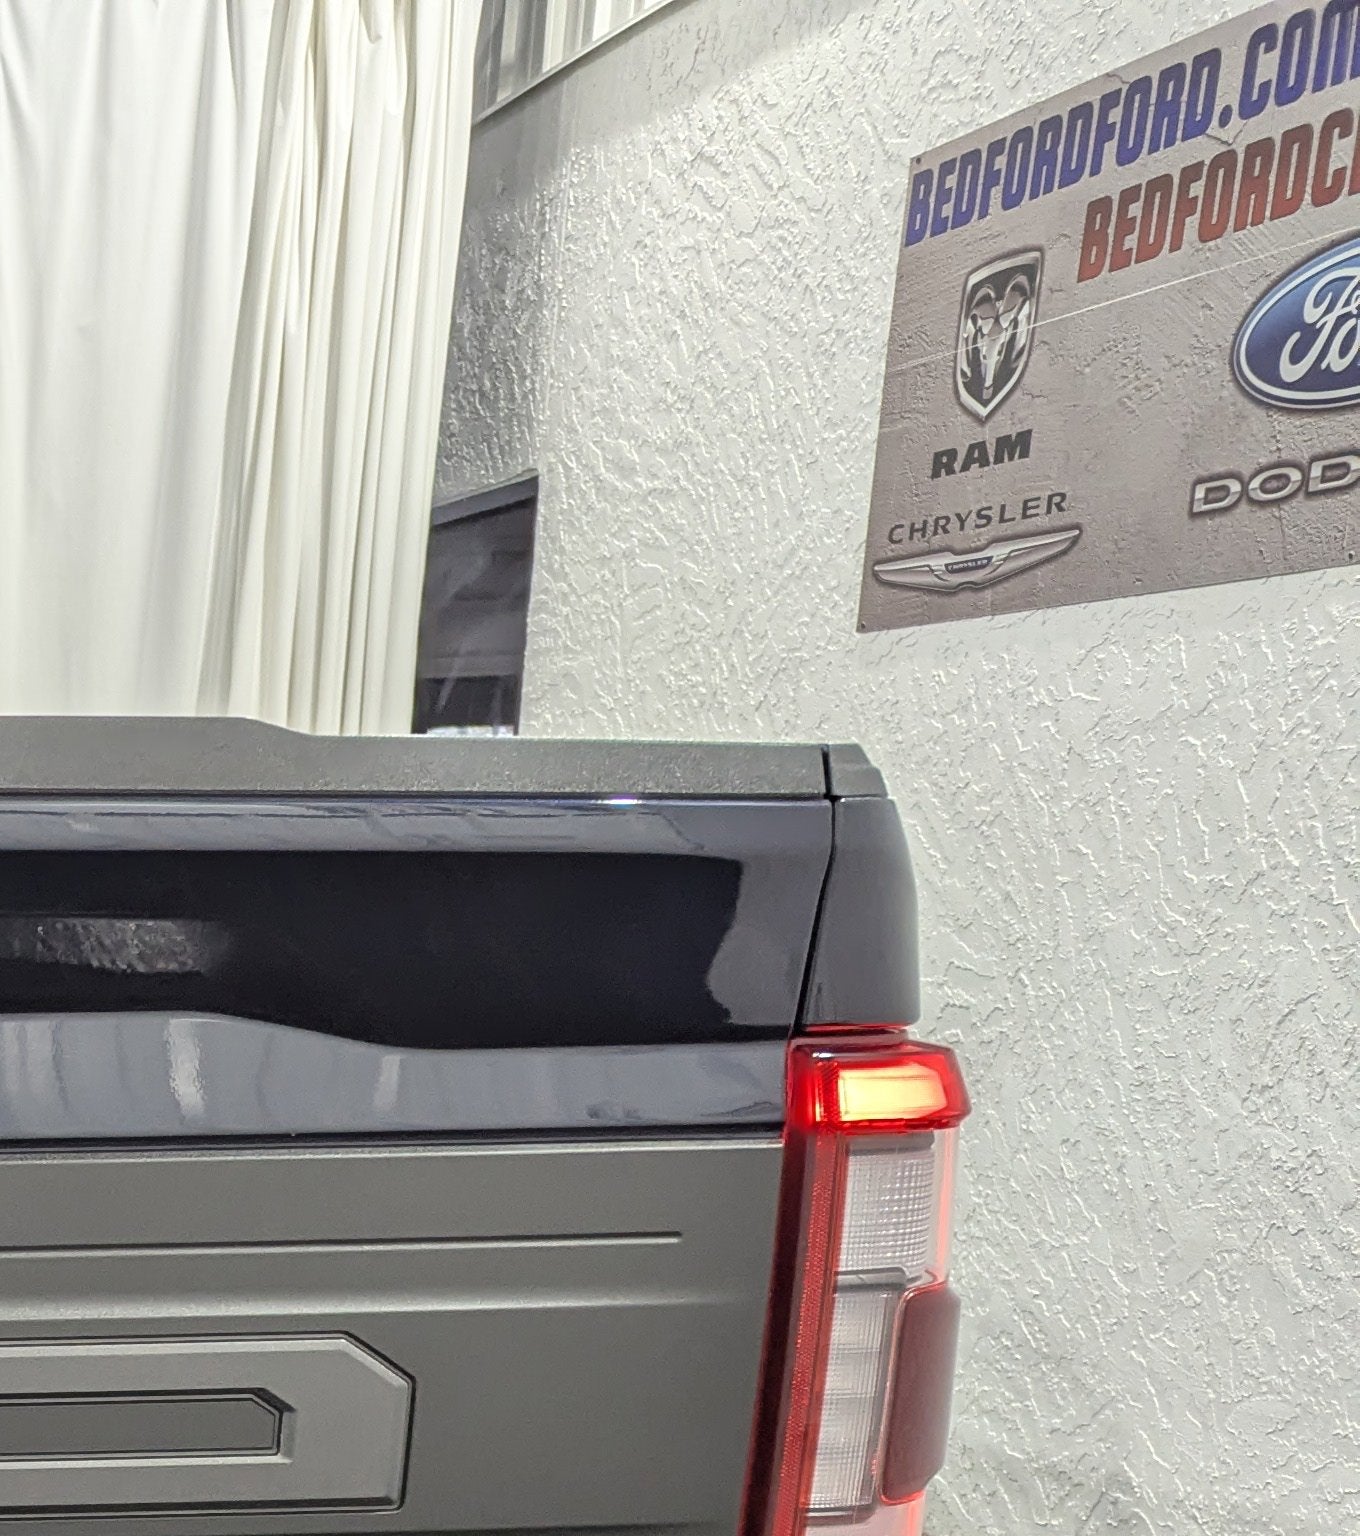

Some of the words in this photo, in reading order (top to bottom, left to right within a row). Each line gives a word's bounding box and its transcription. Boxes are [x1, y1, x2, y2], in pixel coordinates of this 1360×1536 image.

[904, 0, 1360, 247] BEDFORDFORD.COM
[1280, 266, 1360, 383] Fo
[931, 428, 1032, 480] RAM
[887, 492, 1068, 545] CHRYSLER
